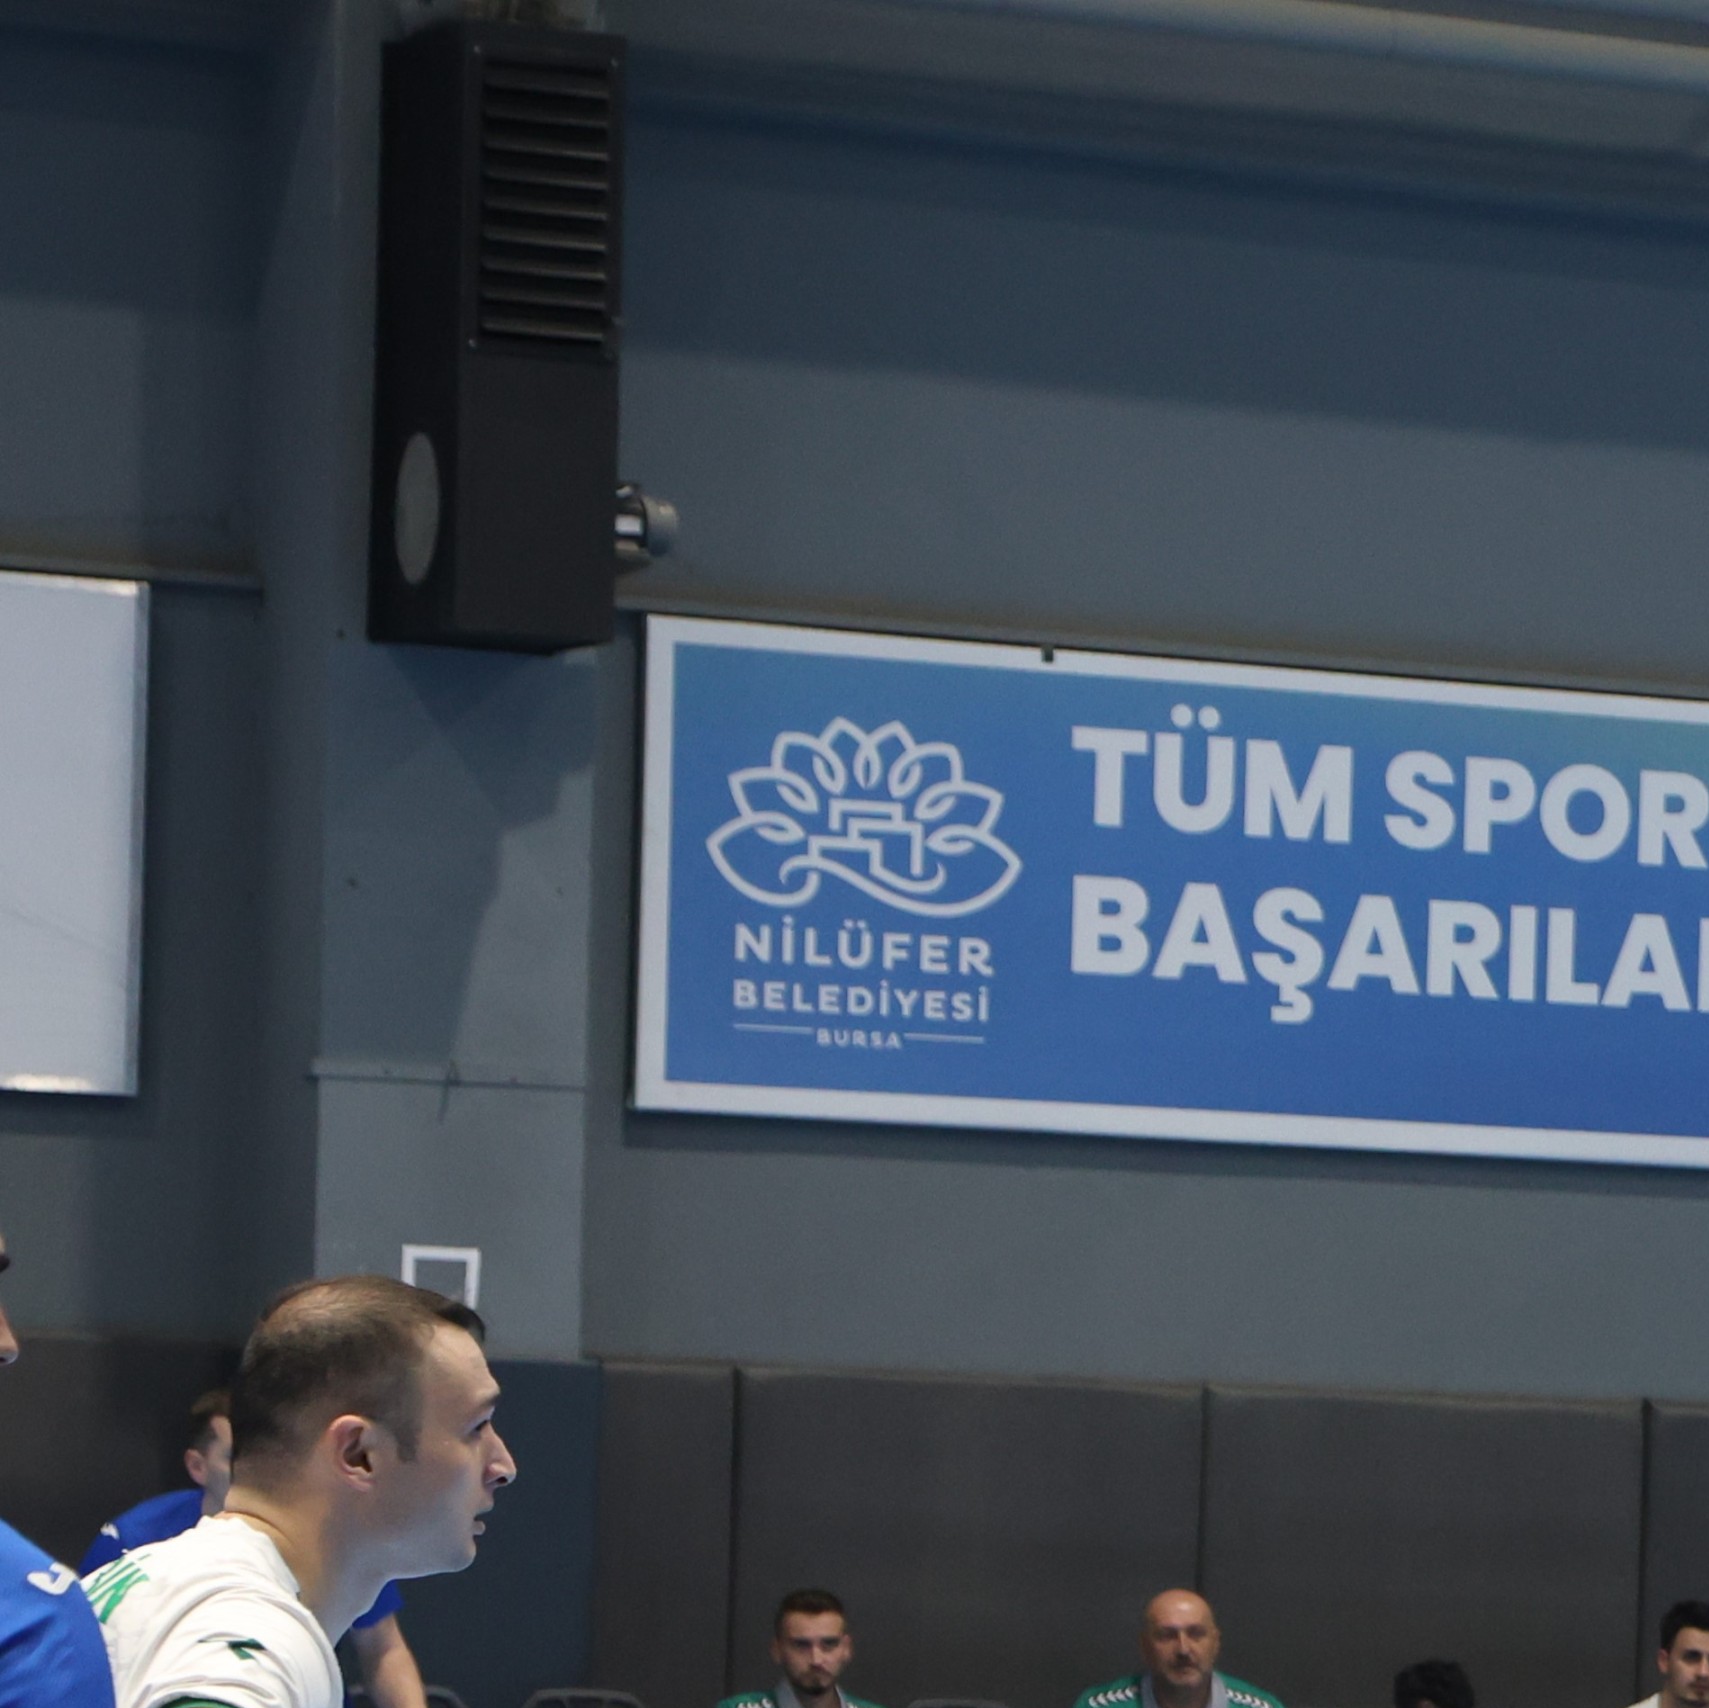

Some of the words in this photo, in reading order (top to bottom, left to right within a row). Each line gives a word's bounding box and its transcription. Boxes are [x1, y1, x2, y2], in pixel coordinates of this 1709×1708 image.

[1073, 705, 1352, 841] TÜM
[734, 914, 994, 977] NİLÜFER
[733, 979, 990, 1023] BELEDİYESİ
[816, 1027, 903, 1049] BURSA
